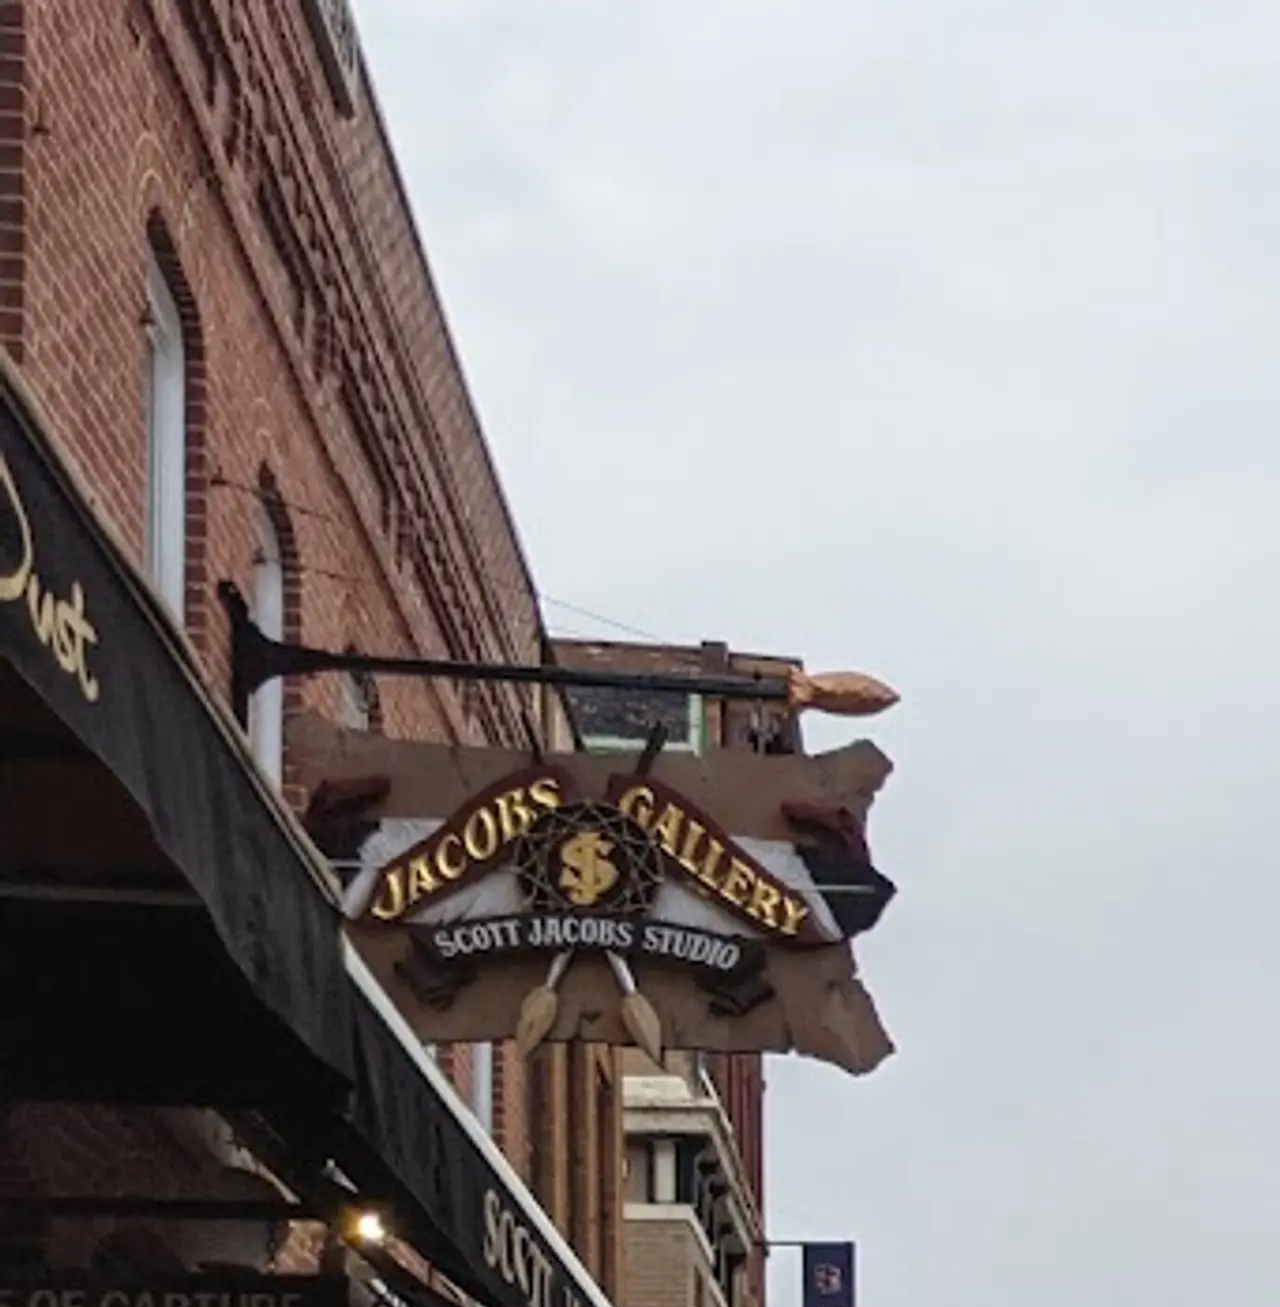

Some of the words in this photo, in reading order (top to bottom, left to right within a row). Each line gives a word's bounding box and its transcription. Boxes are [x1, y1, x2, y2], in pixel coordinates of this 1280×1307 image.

[371, 777, 563, 921] JACOBS
[618, 786, 810, 936] GALLERY
[435, 922, 522, 958] SCOTT
[528, 917, 633, 947] JACOBS
[643, 925, 741, 971] STUDIO
